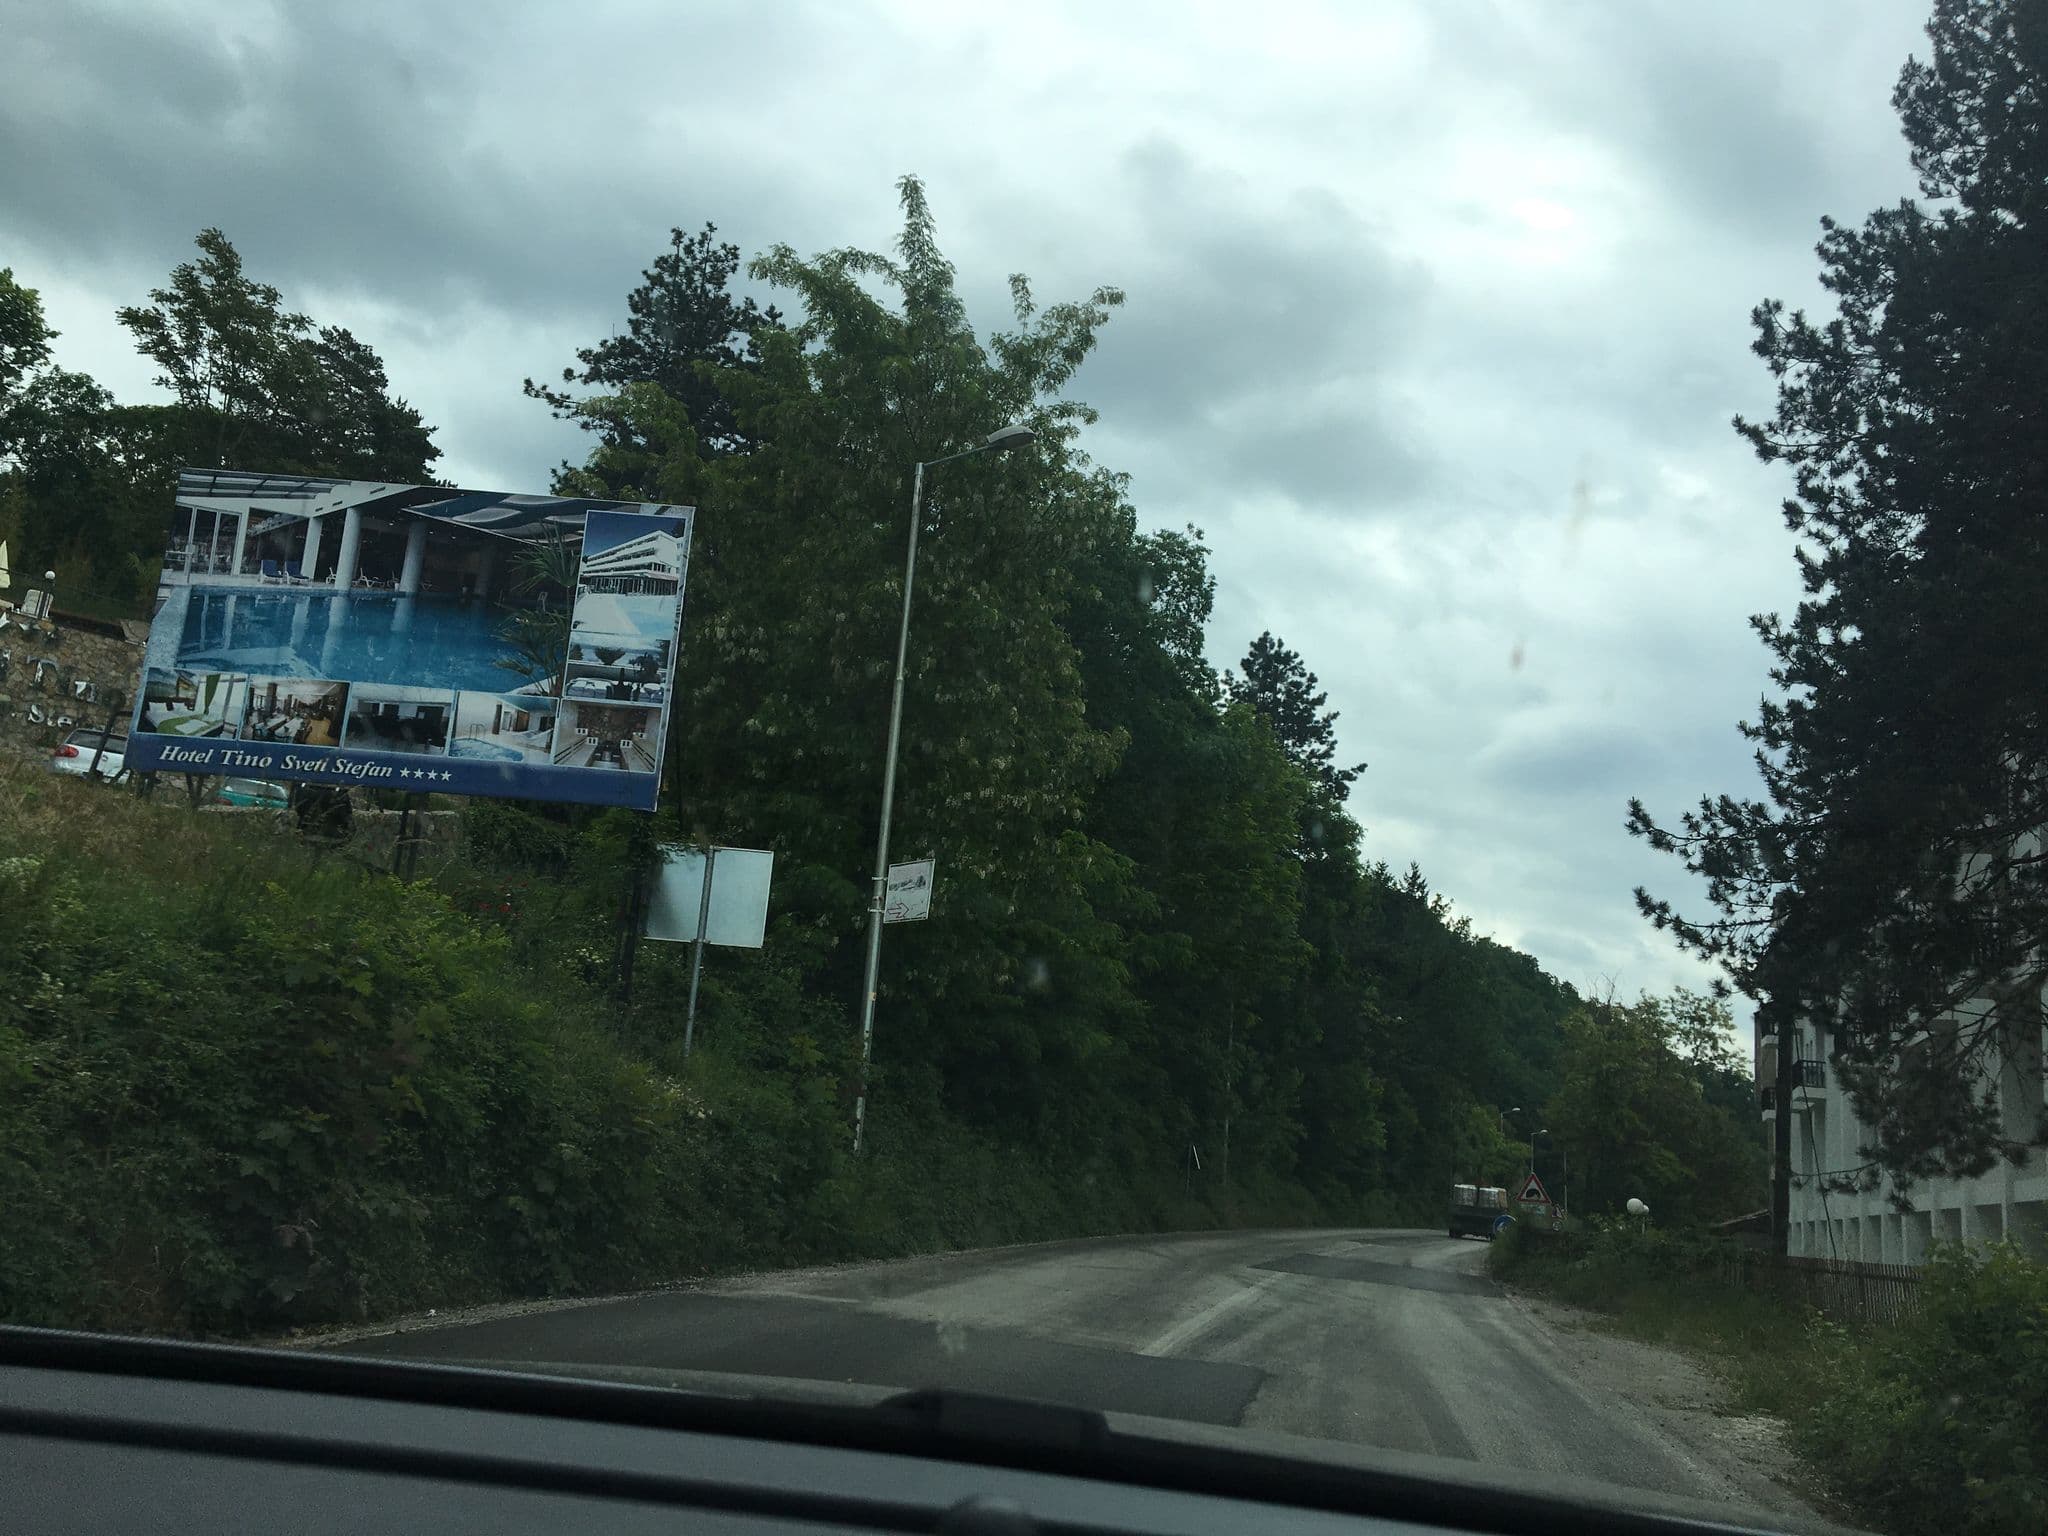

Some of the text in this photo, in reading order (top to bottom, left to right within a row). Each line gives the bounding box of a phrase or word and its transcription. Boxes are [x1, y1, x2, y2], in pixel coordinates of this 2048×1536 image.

[159, 745, 393, 779] Hotel Tino Sveti Stefan
